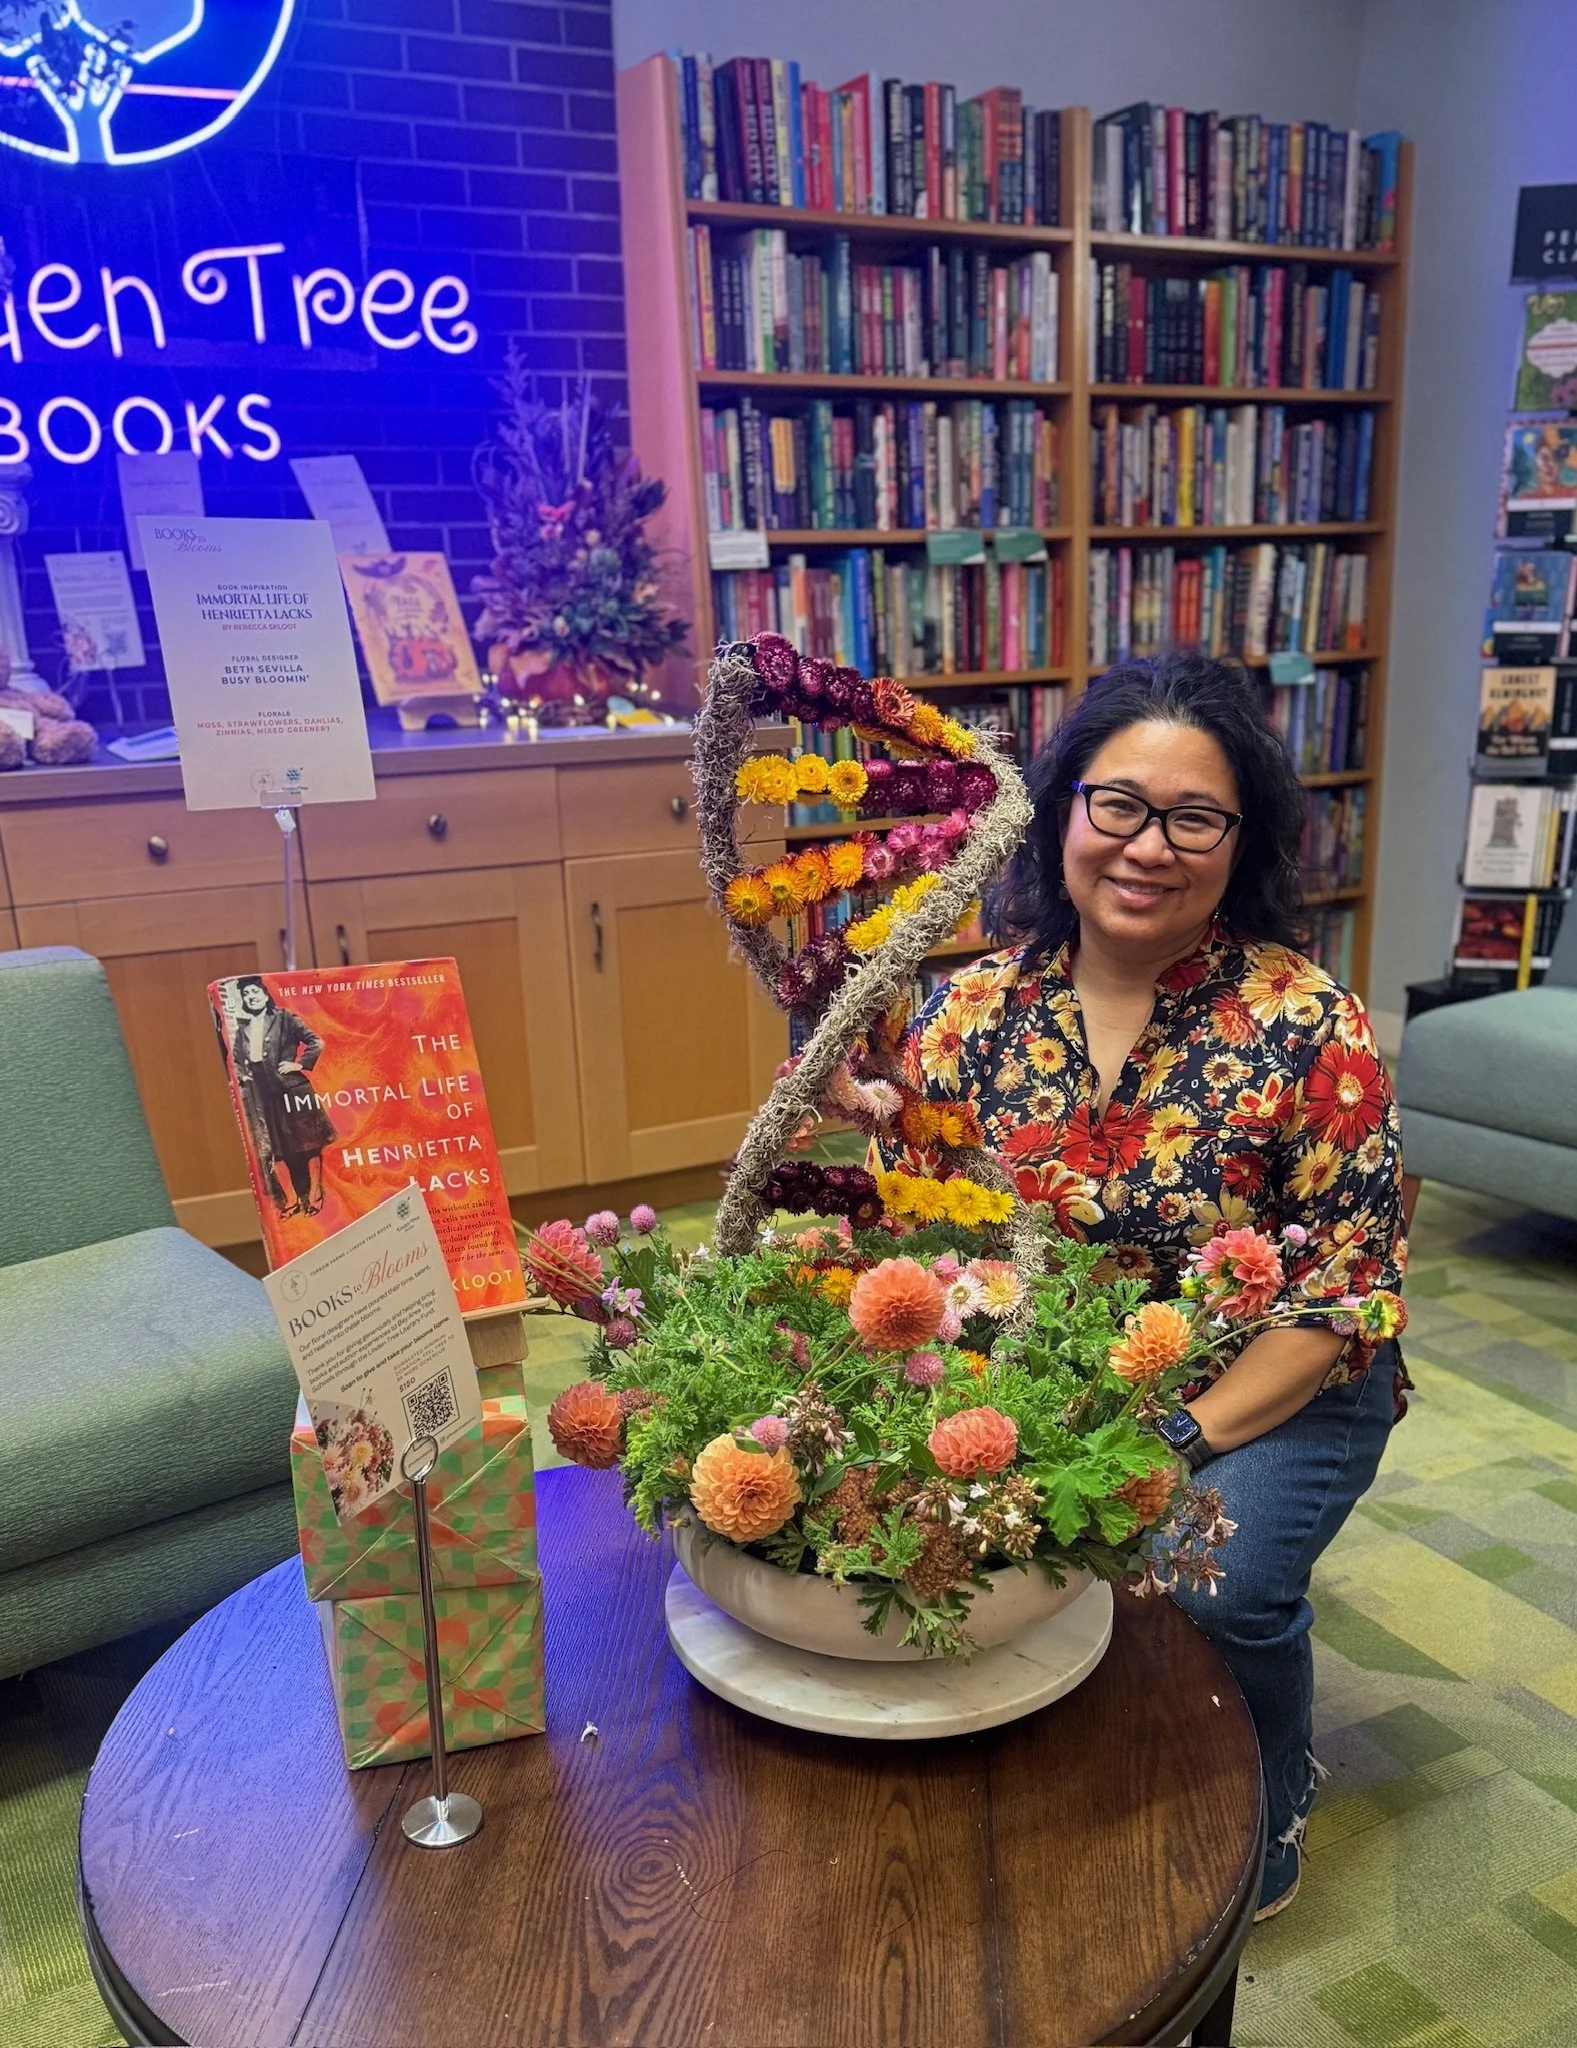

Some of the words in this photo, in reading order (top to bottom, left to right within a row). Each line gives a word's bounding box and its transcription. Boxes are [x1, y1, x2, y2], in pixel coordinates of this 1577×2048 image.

[1543, 228, 1577, 247] PE
[182, 243, 478, 355] Tree
[154, 528, 197, 540] BOOKS
[173, 540, 222, 553] Blooms
[196, 593, 265, 605] IMMORTAL
[266, 593, 291, 605] LIFE
[292, 593, 310, 605] OF
[201, 608, 272, 620] HENRIETTA
[273, 608, 313, 620] LACKS
[224, 665, 254, 674] BETH
[258, 664, 304, 673] SEVILLA
[221, 676, 250, 685] BUSY
[287, 726, 331, 734] GREENERY
[278, 987, 297, 997] THE
[302, 985, 322, 995] NEW
[327, 982, 352, 992] YORK
[356, 979, 384, 990] TIMES
[388, 974, 445, 987] BESTSELLER
[412, 1033, 462, 1054] THE
[283, 1082, 412, 1113] IMMORTAL
[421, 1075, 470, 1098] LIFE
[446, 1103, 474, 1120] OF
[342, 1134, 483, 1168] HENRIETTA
[408, 1167, 490, 1193] LACKS
[427, 1207, 440, 1215] ells
[442, 1202, 469, 1212] without
[442, 1215, 458, 1223] cells
[467, 1240, 488, 1250] found
[466, 1253, 474, 1261] be
[289, 1285, 352, 1337] BOOKS
[358, 1242, 427, 1294] Blooms
[452, 1269, 512, 1291] KLOOT
[298, 1342, 311, 1352] Our
[326, 1313, 354, 1335] designers
[353, 1305, 367, 1316] have
[367, 1291, 387, 1309] poured
[387, 1283, 400, 1295] their
[307, 1362, 325, 1375] Thank
[325, 1355, 336, 1366] you
[336, 1349, 345, 1357] for
[345, 1338, 362, 1353] giving
[362, 1318, 391, 1342] generously
[392, 1309, 402, 1320] and
[401, 1298, 421, 1313] helping
[420, 1288, 435, 1301] bring
[302, 1349, 313, 1361] and
[313, 1338, 332, 1352] hearts
[332, 1331, 344, 1341] into
[363, 1366, 375, 1378] give
[375, 1357, 387, 1368] and
[386, 1350, 400, 1361] take
[400, 1341, 413, 1354] your
[413, 1328, 433, 1343] blooms
[309, 1371, 327, 1384] books
[328, 1362, 339, 1373] and
[339, 1350, 357, 1365] author
[311, 1374, 335, 1393] Schools
[334, 1359, 357, 1377] through
[357, 1353, 367, 1362] the
[367, 1341, 386, 1356] Linden
[386, 1332, 399, 1342] Tree
[399, 1376, 415, 1392] $150
